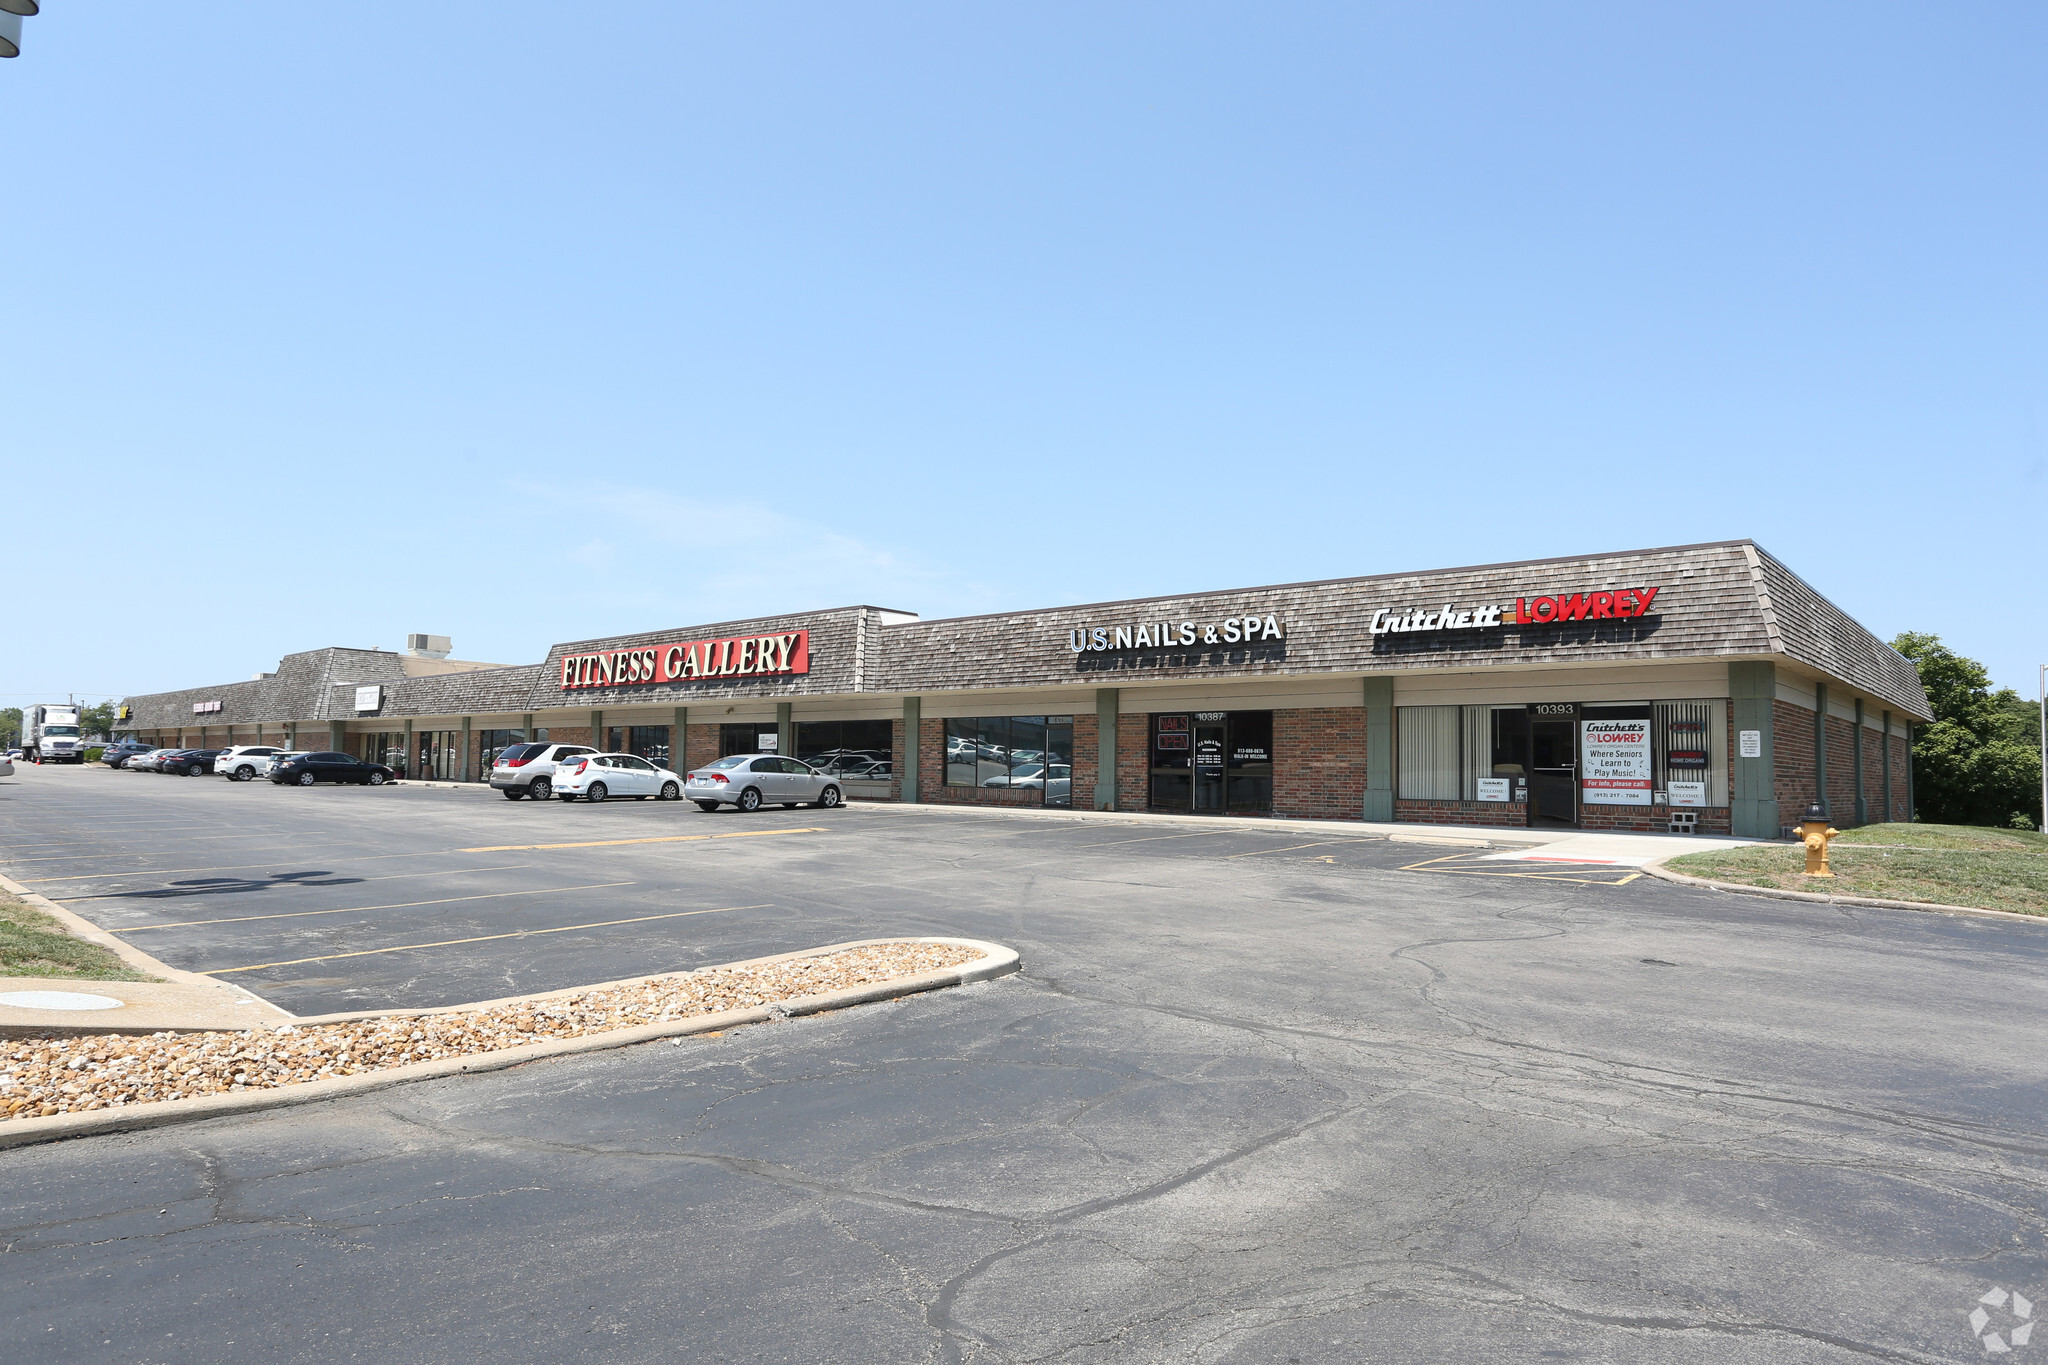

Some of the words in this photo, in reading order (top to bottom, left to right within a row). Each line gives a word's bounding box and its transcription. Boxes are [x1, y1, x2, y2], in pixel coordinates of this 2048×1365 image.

[1369, 605, 1502, 634] Critchett
[1516, 587, 1660, 625] LOWREY
[1115, 621, 1197, 649] NAILS
[1204, 624, 1219, 645] &
[1223, 615, 1283, 642] SPA
[561, 649, 657, 687] FITNESS
[664, 634, 800, 679] GALLERY
[1535, 704, 1574, 715] 10393
[1198, 712, 1224, 721] 10387
[1160, 717, 1187, 731] NAILS
[1586, 722, 1645, 732] Critchett's
[1159, 734, 1189, 748] OPEN
[1597, 733, 1645, 743] LOWREY
[1590, 750, 1614, 758] Where
[1615, 750, 1643, 758] Seniors
[1600, 759, 1622, 767] Learn
[1594, 769, 1610, 778] Play
[1612, 769, 1636, 777] Music!
